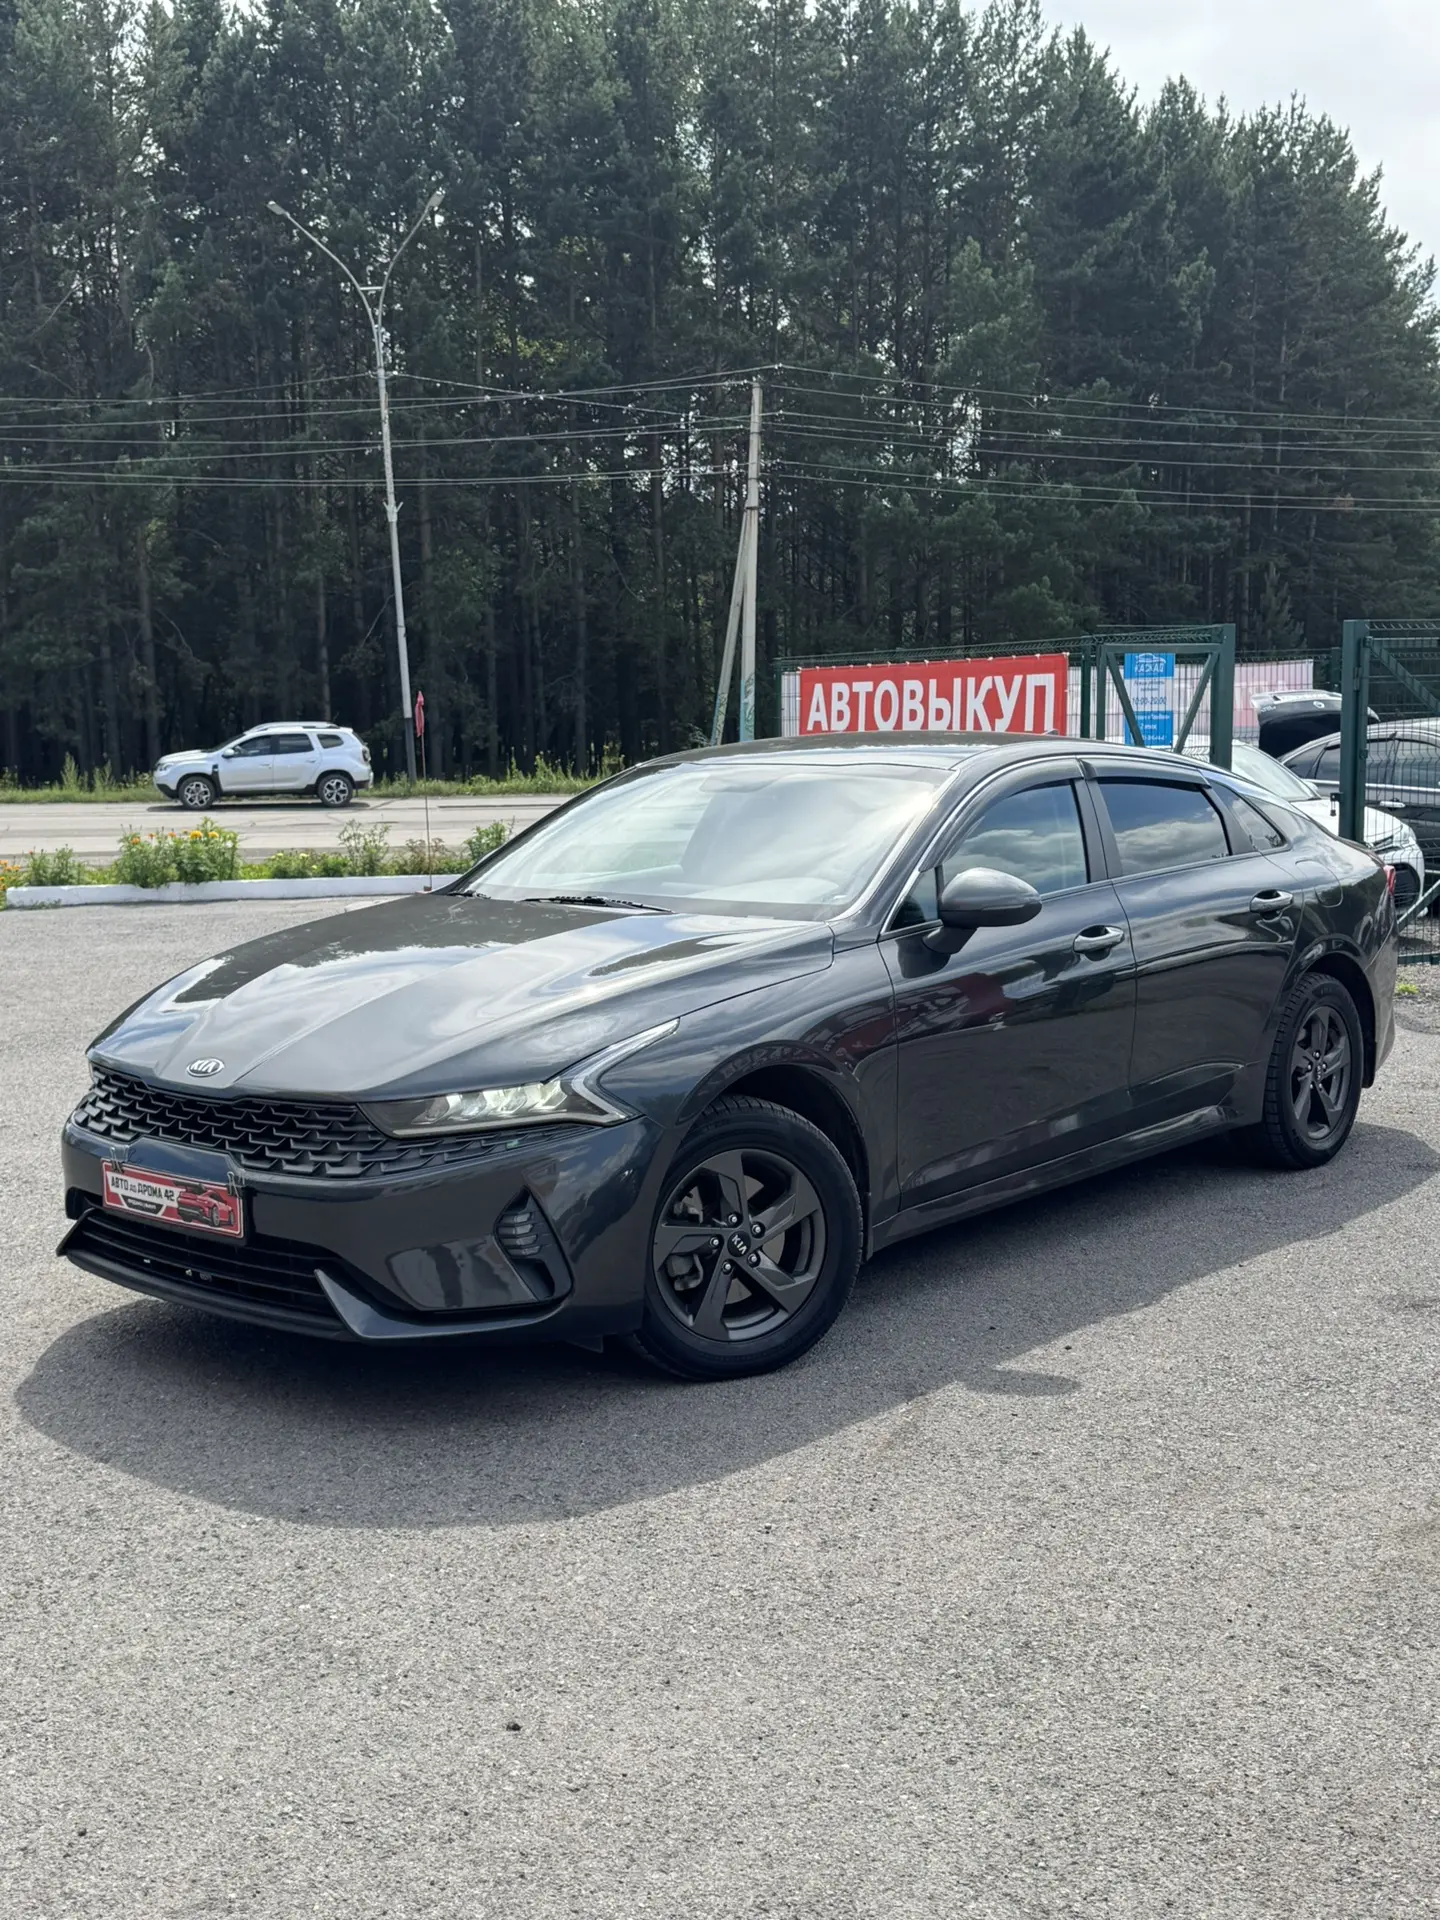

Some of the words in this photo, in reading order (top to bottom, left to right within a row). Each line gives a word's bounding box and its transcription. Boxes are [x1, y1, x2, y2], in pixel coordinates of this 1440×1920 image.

[806, 673, 1055, 733] АВТОВЫКУП
[111, 1176, 129, 1191] АВТО
[164, 1189, 176, 1202] 42
[731, 1234, 748, 1255] KIA
